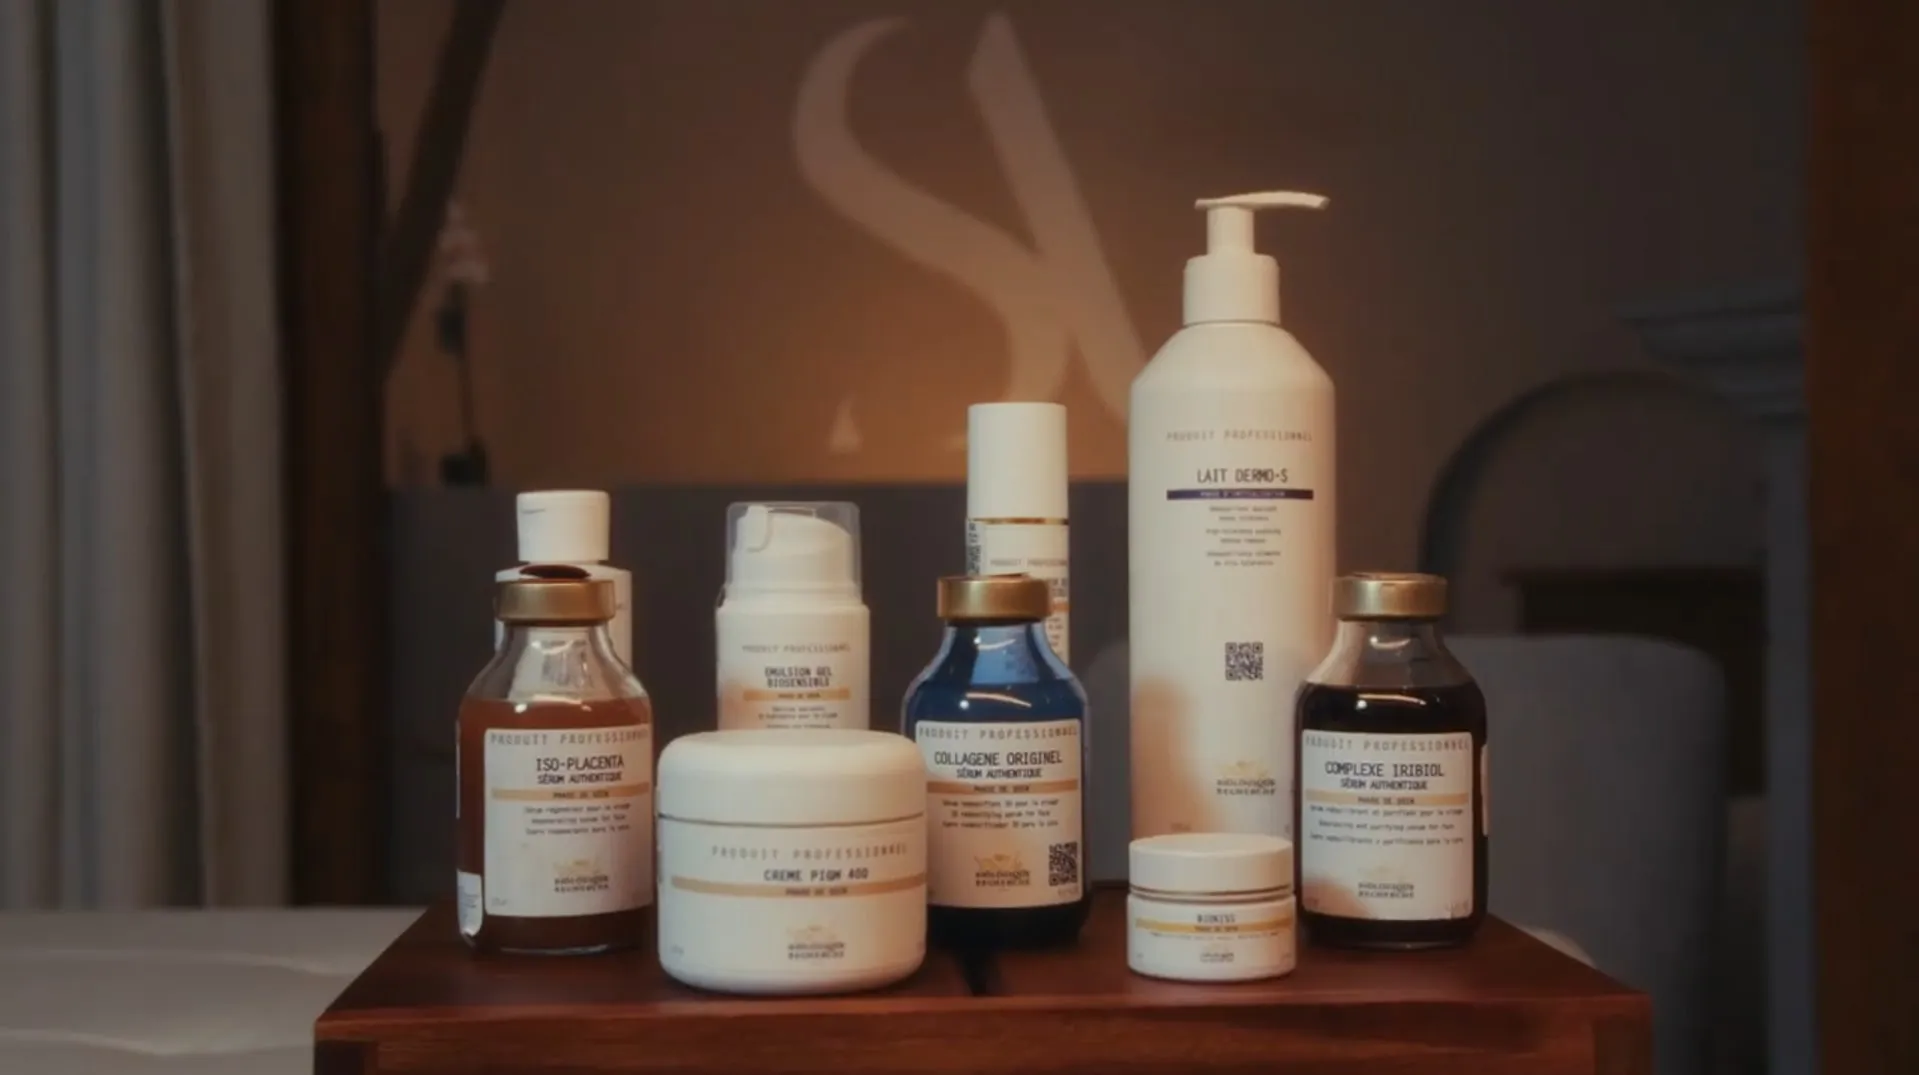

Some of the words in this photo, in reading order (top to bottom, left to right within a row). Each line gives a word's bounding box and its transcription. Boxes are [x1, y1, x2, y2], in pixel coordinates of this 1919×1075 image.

[1197, 468, 1228, 484] LAIT
[765, 666, 811, 678] EMULSION
[767, 677, 830, 688] BIOSENSIBLE
[536, 754, 625, 772] ISO-PLACENTA
[934, 751, 1000, 766] COLLAGENE
[1006, 750, 1063, 765] ORIGINEL
[986, 768, 1042, 779] AUTHENTIQUE
[1325, 761, 1385, 777] COMPLEXE
[1392, 763, 1445, 778] IRIBIOL
[537, 772, 565, 784] SÉRUM
[568, 771, 623, 784] AUTHENTIQUE
[1370, 779, 1428, 791] AUTHENTIQUE
[711, 845, 779, 861] PRODUIT
[763, 868, 802, 882] CREME
[848, 867, 869, 880] 400
